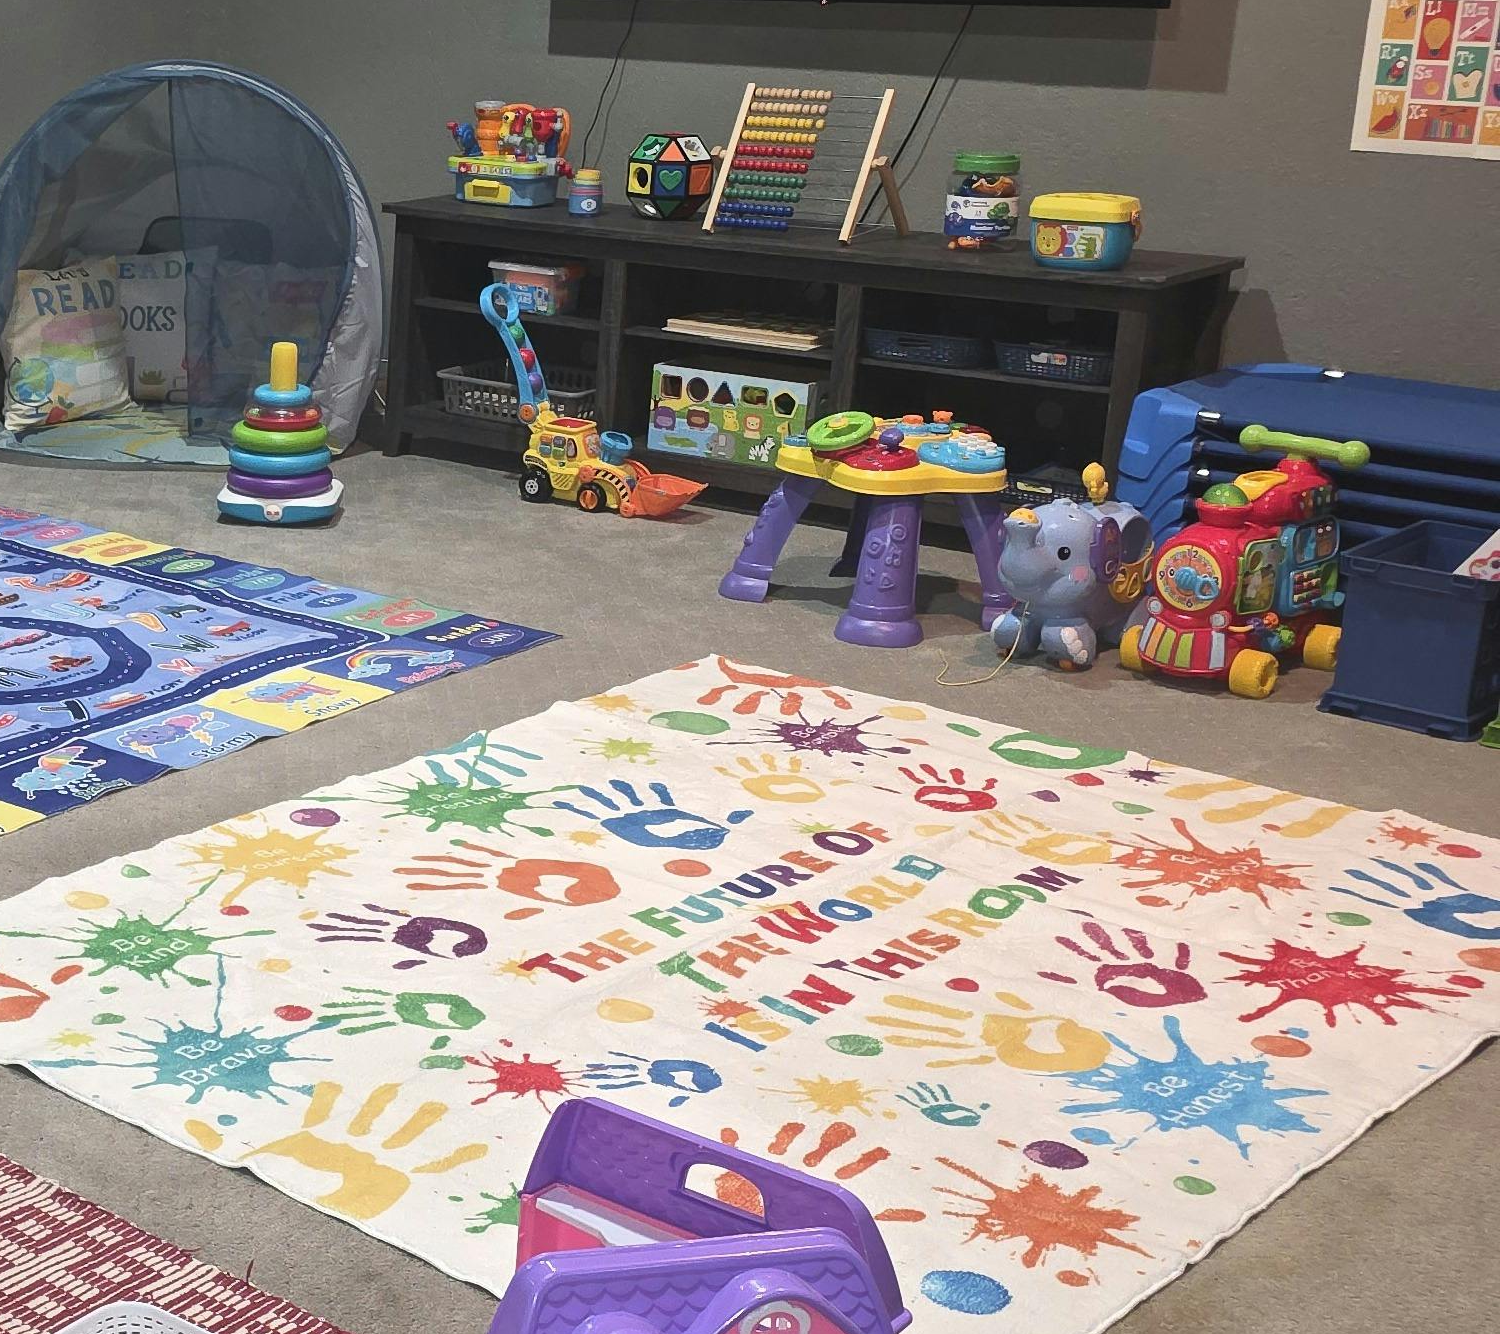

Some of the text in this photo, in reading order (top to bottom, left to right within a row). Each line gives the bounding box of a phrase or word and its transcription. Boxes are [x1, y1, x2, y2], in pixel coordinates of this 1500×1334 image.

[118, 259, 183, 280] EAD
[30, 279, 115, 316] READ
[518, 821, 893, 983] THE FUTURE OF
[656, 854, 947, 993] THE WORLD
[109, 933, 153, 954] Be
[123, 937, 193, 969] Kind
[703, 865, 1085, 1053] IS IN THIS ROOM
[173, 1038, 224, 1061] Be
[176, 1040, 279, 1086] Brave
[1143, 1075, 1189, 1098] Be
[1160, 1069, 1256, 1126] Honest
